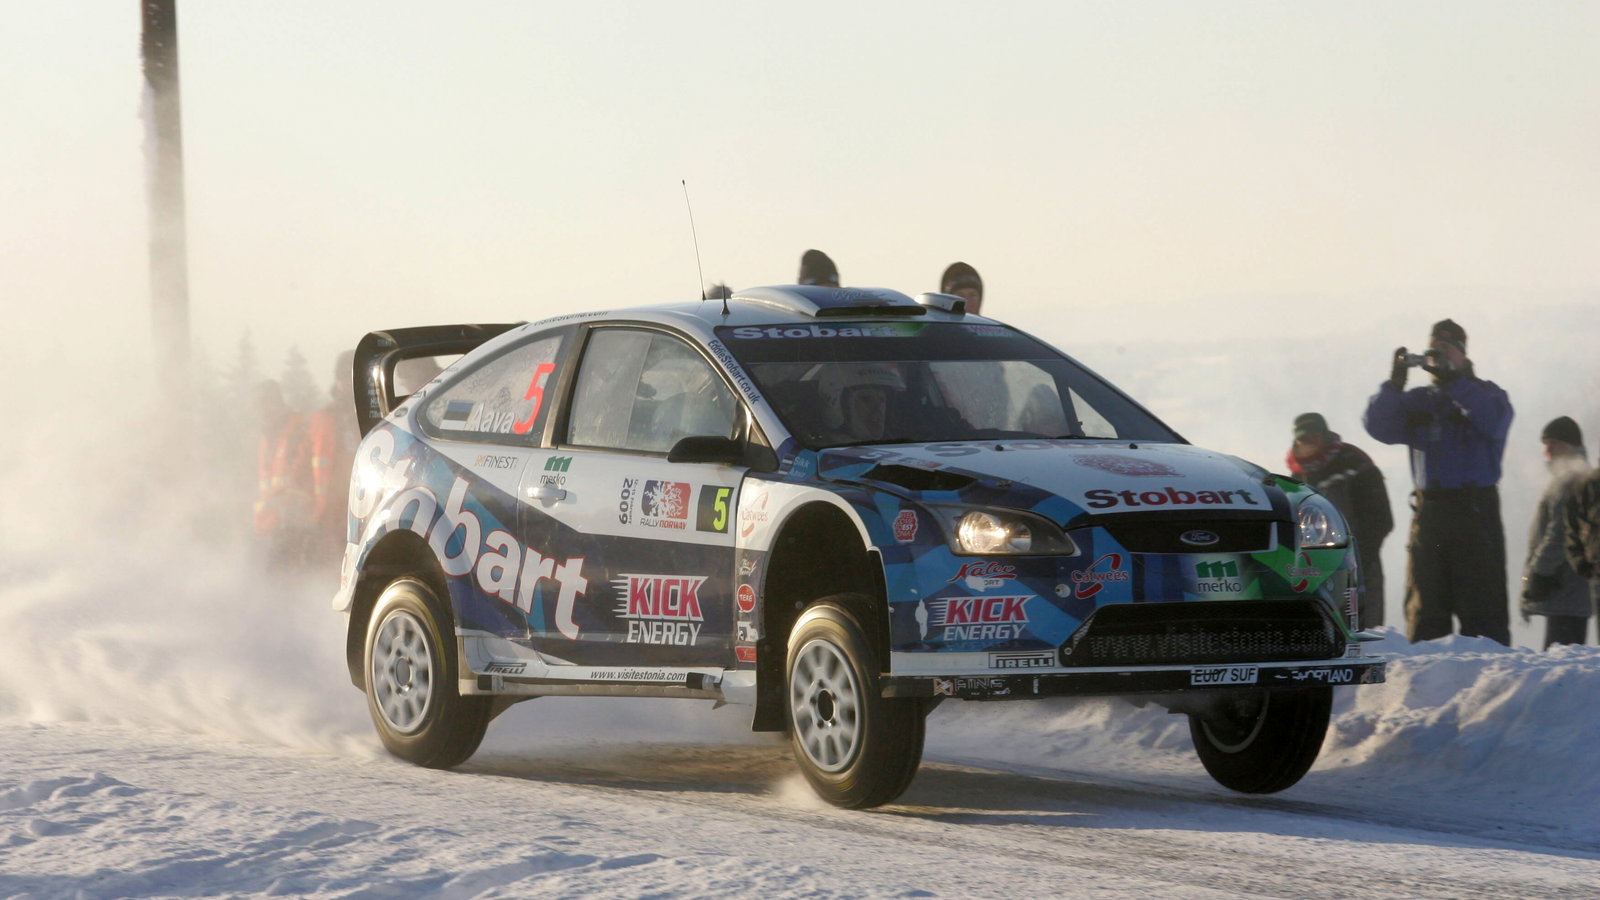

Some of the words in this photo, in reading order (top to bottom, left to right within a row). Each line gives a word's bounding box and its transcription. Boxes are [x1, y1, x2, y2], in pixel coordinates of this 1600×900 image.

[733, 325, 898, 339] Stobart
[513, 363, 558, 435] 5
[618, 478, 634, 525] 2009
[1084, 486, 1259, 509] Stobart
[713, 488, 730, 531] 5
[640, 517, 659, 528] RALLY
[349, 429, 589, 641] Stobart
[1197, 579, 1242, 593] merko
[628, 577, 702, 618] KICK
[945, 598, 1028, 624] KICK
[627, 620, 702, 646] ENERGY
[943, 624, 1026, 641] ENERGY
[483, 661, 528, 674] PIRELLI
[990, 652, 1055, 668] PIRELLI
[590, 668, 686, 681] www.visitestonia.com
[1194, 668, 1226, 682] EU07
[1230, 667, 1256, 682] SUF
